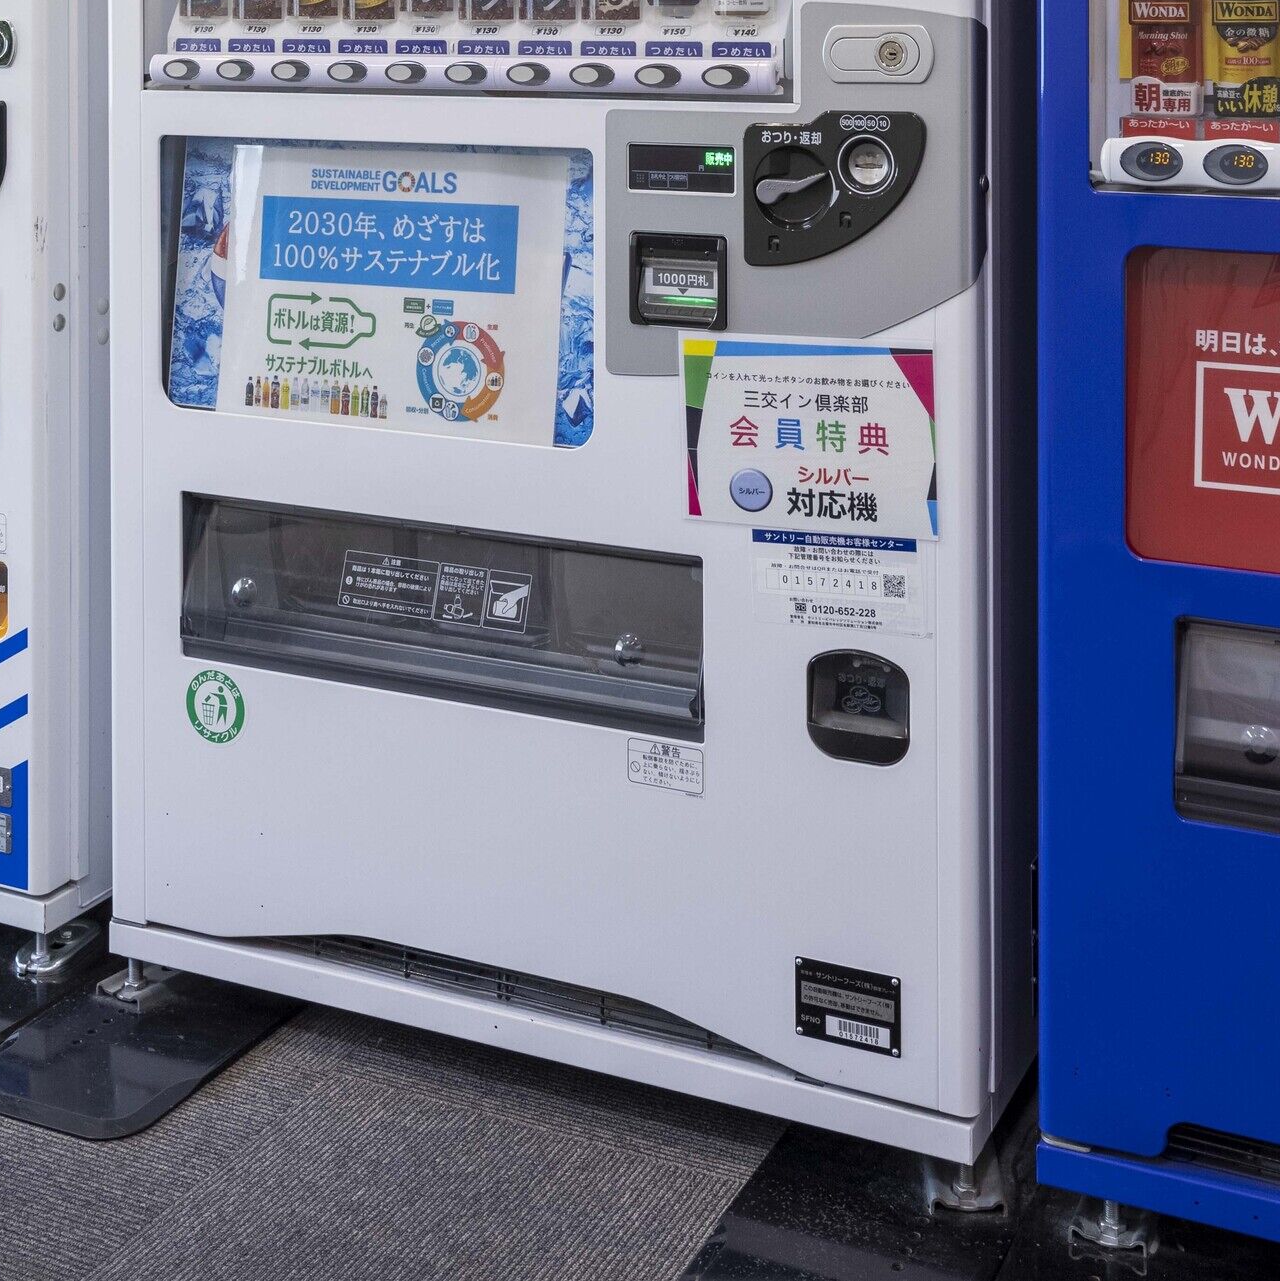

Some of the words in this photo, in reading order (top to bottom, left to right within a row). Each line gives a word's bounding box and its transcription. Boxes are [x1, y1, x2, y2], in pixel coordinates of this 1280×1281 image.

[1134, 2, 1185, 18] WONDA
[1220, 2, 1273, 17] WONDA
[1135, 83, 1160, 112] 朝
[1162, 98, 1191, 112] 専用
[761, 131, 822, 146] おつり・返却
[705, 152, 732, 167] 販売中
[311, 168, 381, 182] SUSTAINABLE
[382, 170, 458, 195] GOALS
[310, 180, 381, 192] DEVELOPMENT
[288, 210, 486, 243] 2030年、めざすは
[272, 243, 500, 281] 100%サステナブル化
[658, 272, 709, 287] 1000円札
[273, 309, 356, 334] ボトルは資源!
[265, 354, 373, 379] サステナブルボトルへ
[743, 391, 869, 414] 三交イン倶楽部
[729, 415, 889, 457] 会員特典
[798, 466, 870, 486] シルバー
[738, 487, 766, 496] シルバー
[786, 486, 878, 523] 対応機
[764, 532, 904, 548] サントリー自動販売機お客様センター
[812, 605, 876, 618] 0120-652-228
[191, 671, 241, 699] のんだあとは
[194, 720, 238, 742] リサイクル
[661, 744, 680, 758] 警告
